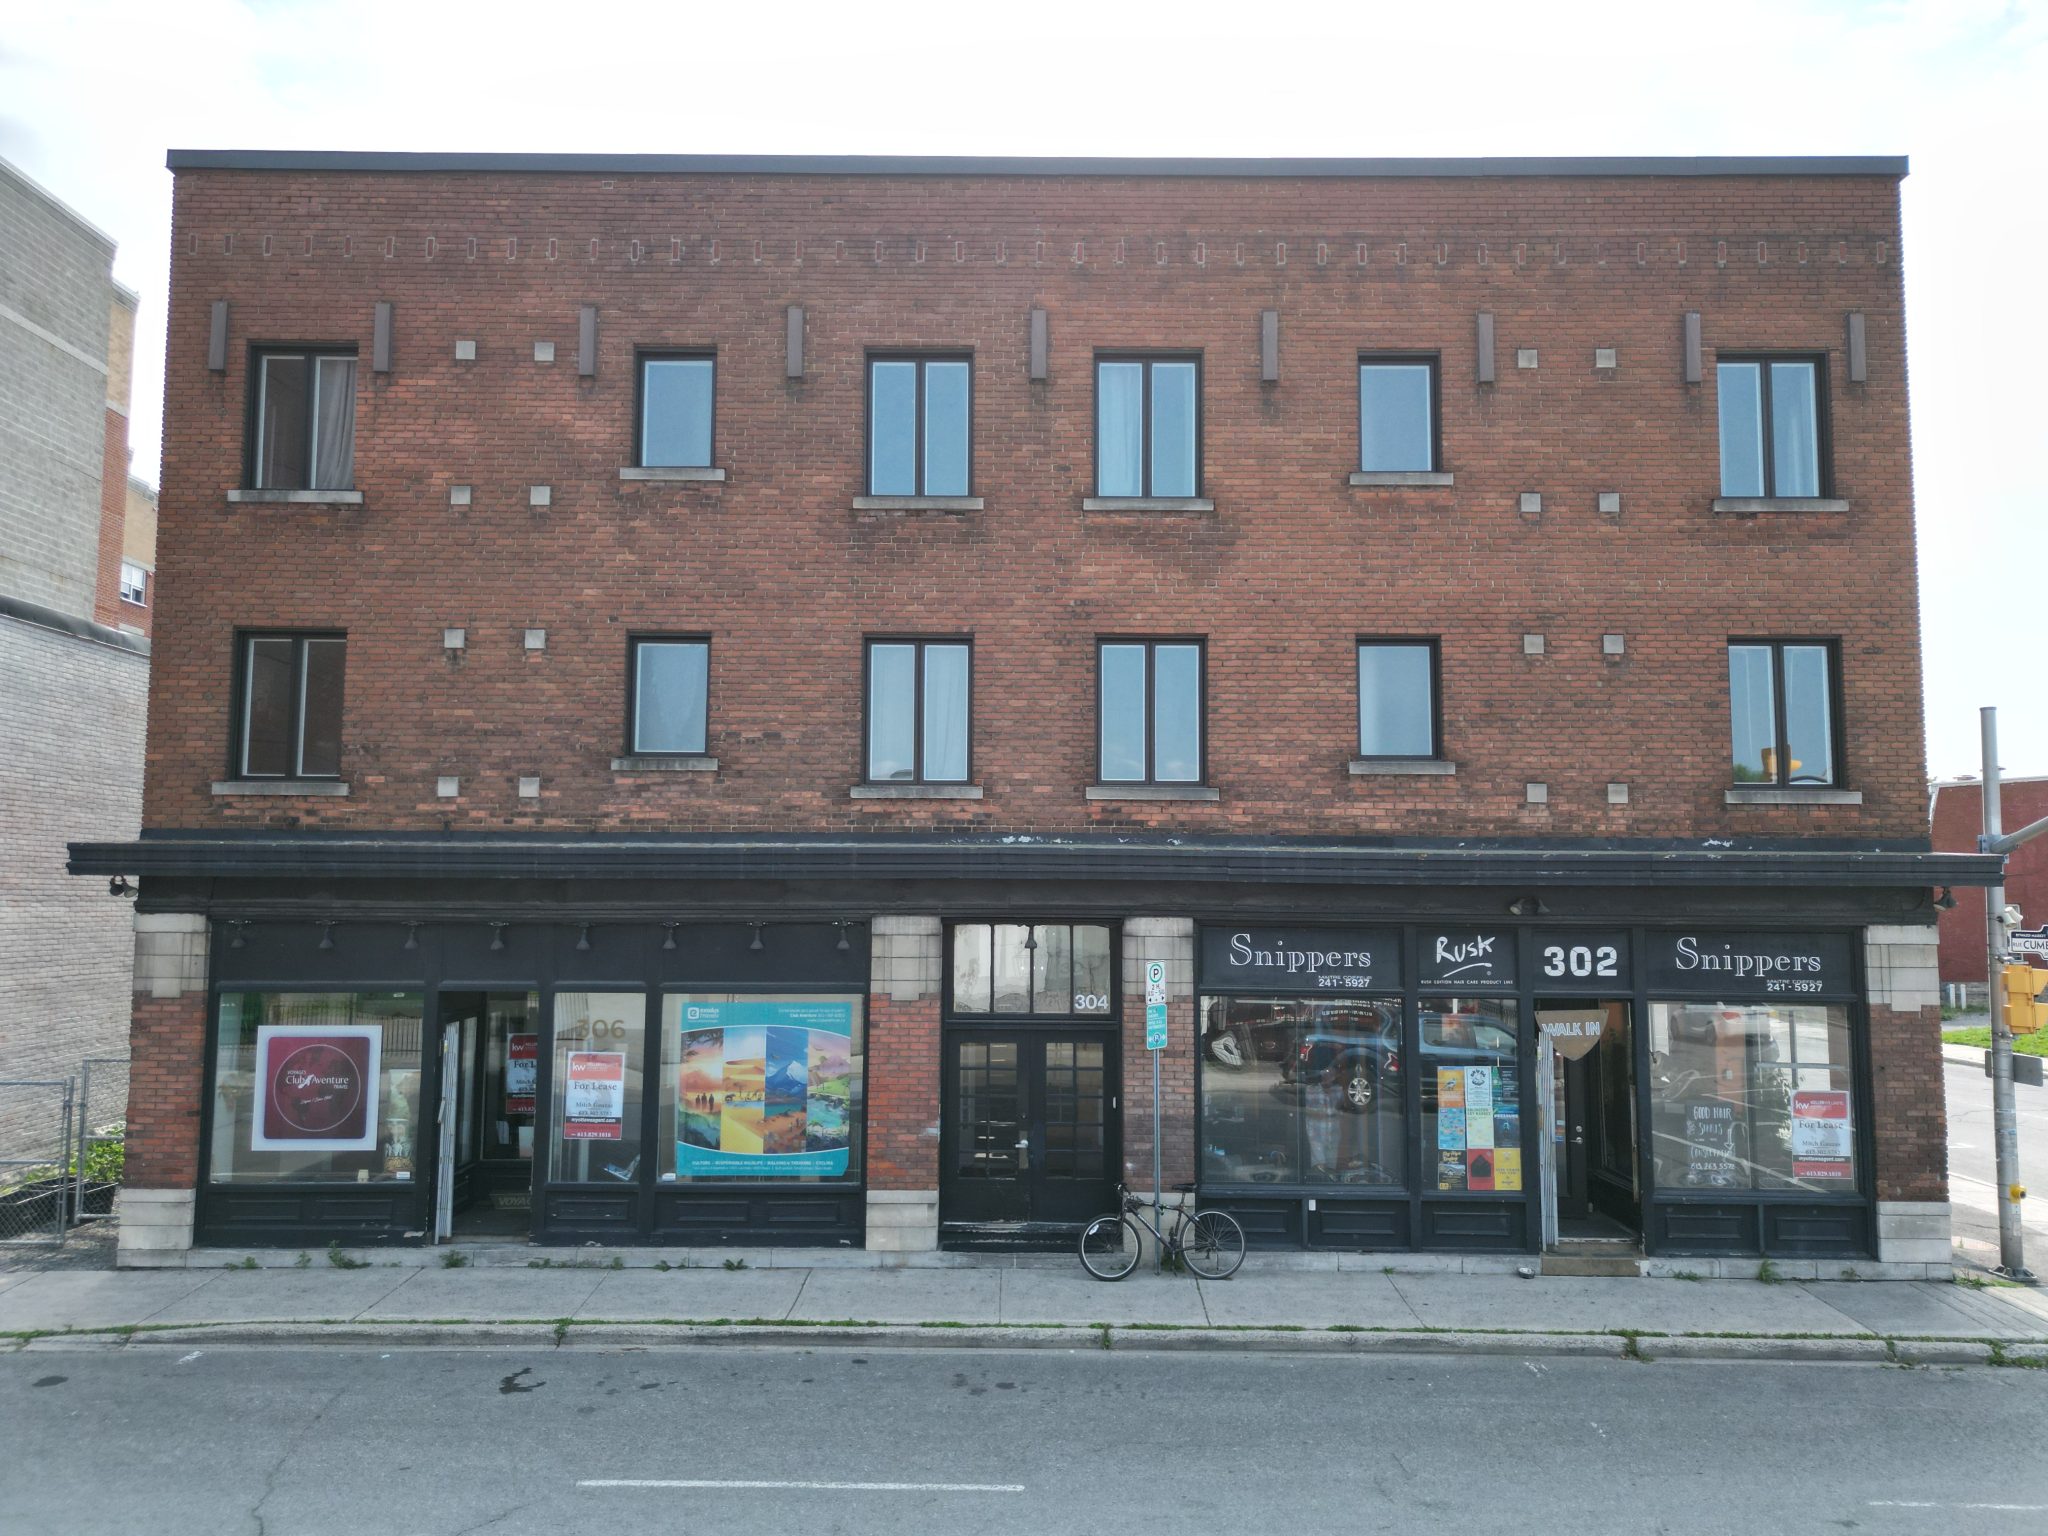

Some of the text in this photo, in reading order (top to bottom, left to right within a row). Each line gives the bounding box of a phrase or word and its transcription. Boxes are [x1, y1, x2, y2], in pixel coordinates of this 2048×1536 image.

[1230, 933, 1371, 973] Snippers
[1675, 936, 1821, 977] Snippers
[1543, 946, 1618, 977] 302
[1153, 968, 1159, 979] P
[1074, 994, 1109, 1010] 304
[1542, 1022, 1601, 1037] WALK IN
[573, 1062, 587, 1072] kw
[285, 1075, 349, 1085] Club Aventure
[574, 1081, 618, 1091] For Lease
[1795, 1100, 1810, 1110] kw
[1799, 1120, 1844, 1129] For Lease
